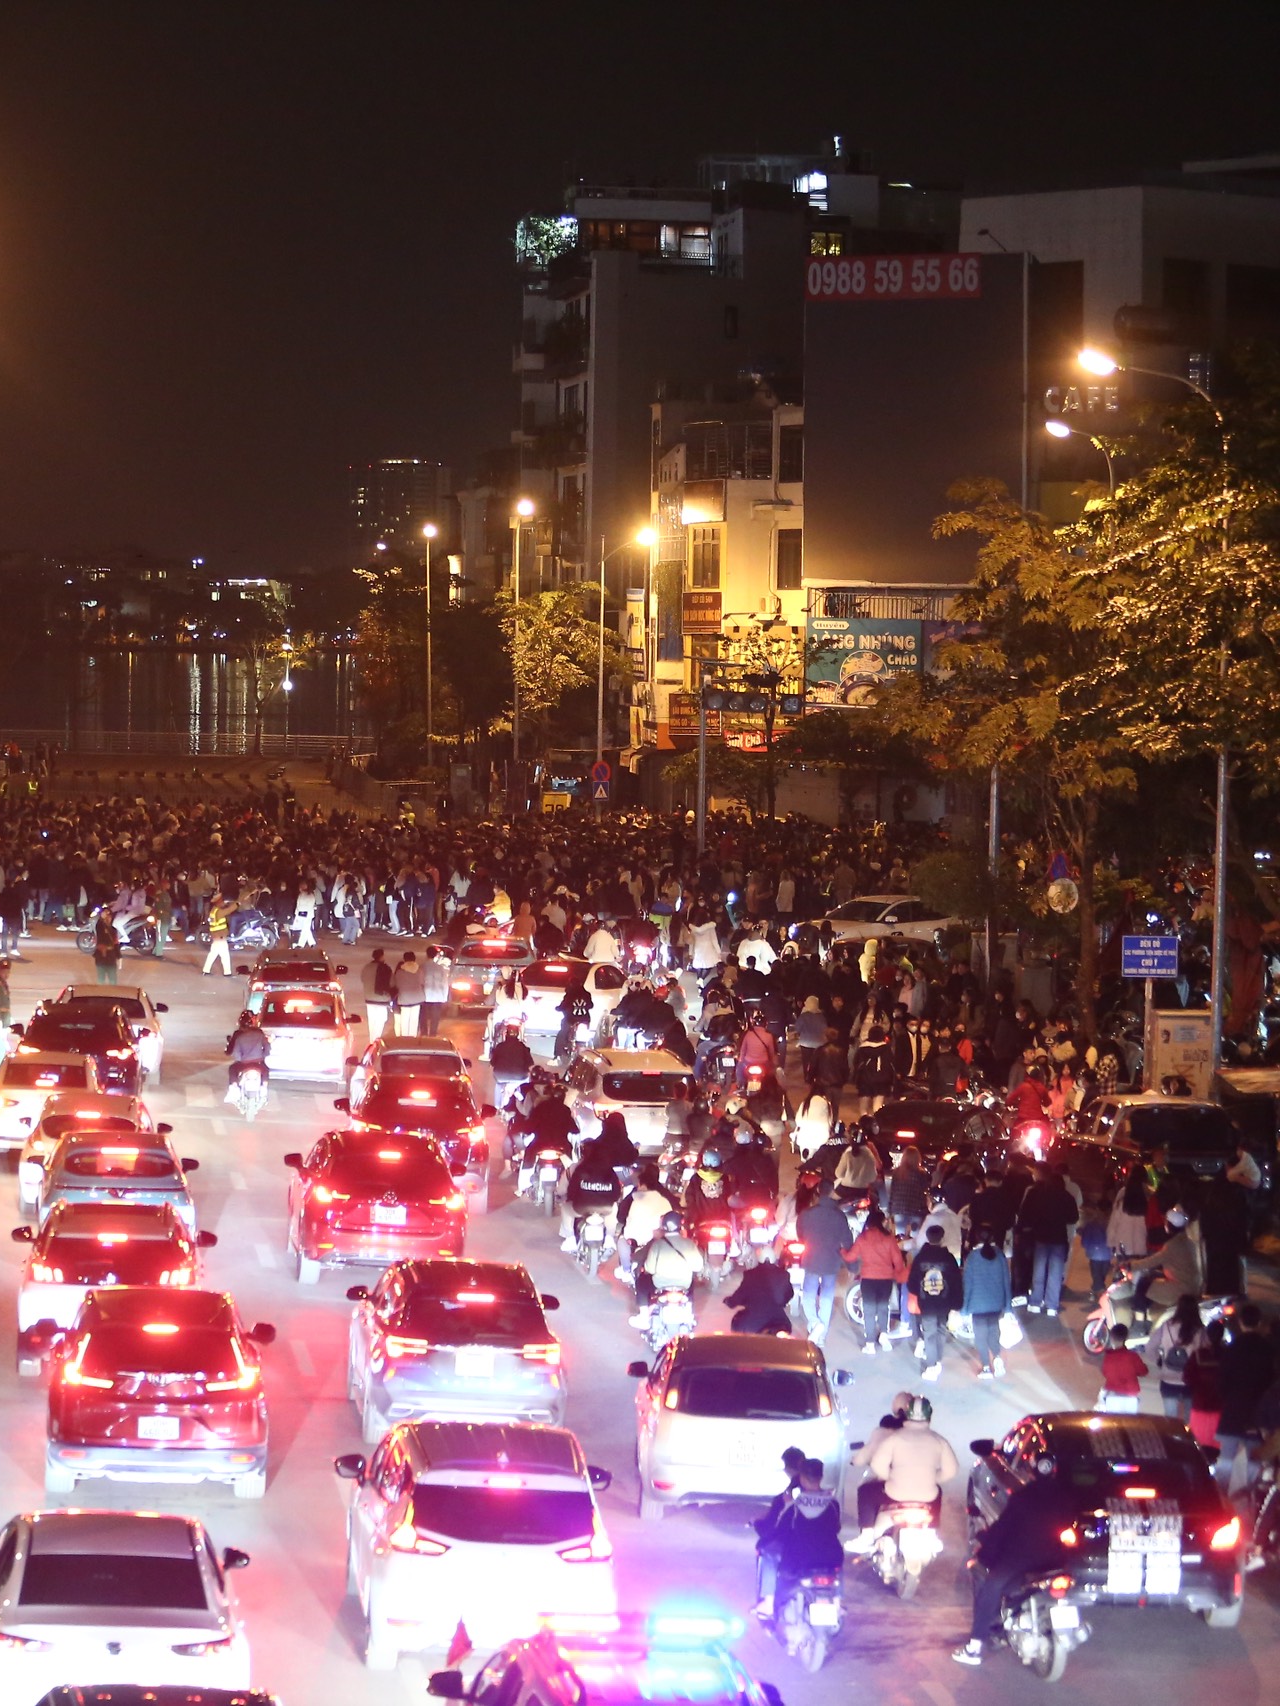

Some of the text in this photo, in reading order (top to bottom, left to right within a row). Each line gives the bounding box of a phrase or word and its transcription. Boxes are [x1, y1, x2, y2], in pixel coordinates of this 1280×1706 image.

[807, 257, 979, 296] 0988 59 55 66
[887, 651, 918, 666] CHÁO
